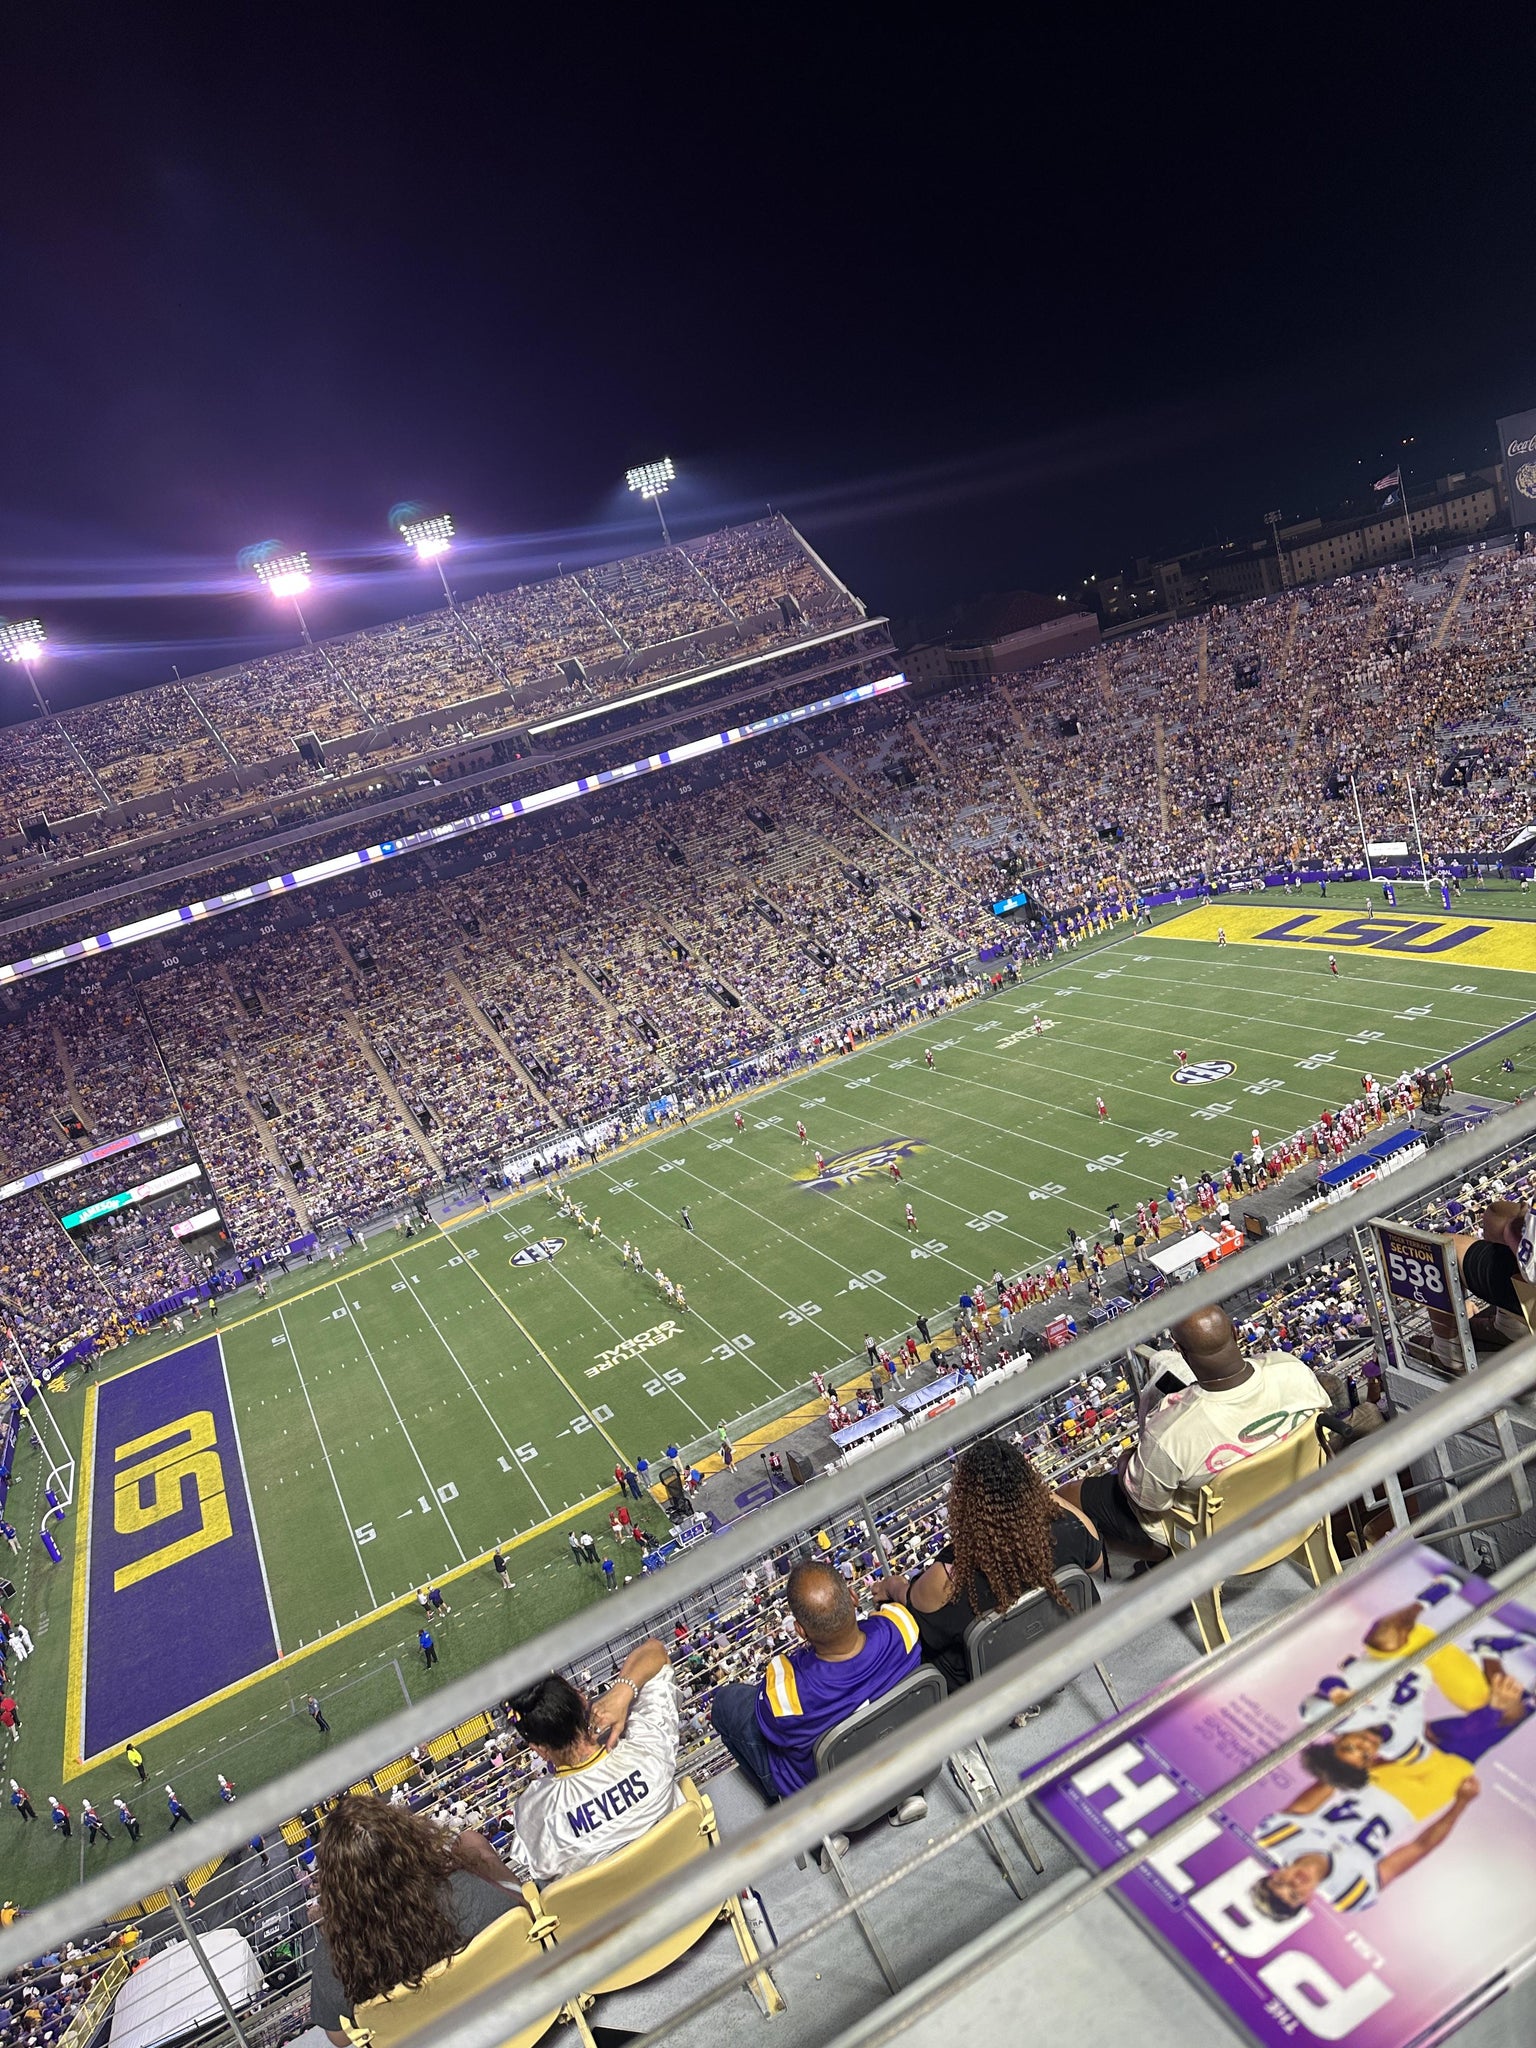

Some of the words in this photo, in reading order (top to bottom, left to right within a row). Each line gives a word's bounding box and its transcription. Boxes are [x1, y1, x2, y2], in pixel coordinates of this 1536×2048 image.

[852, 725, 865, 736] 223
[794, 744, 808, 755] 222
[753, 758, 767, 769] 106
[678, 784, 693, 795] 105
[590, 814, 605, 825] 104
[482, 850, 497, 862] 103
[367, 887, 383, 900] 102
[259, 923, 277, 937] 101
[1251, 914, 1494, 954] LSU
[161, 955, 180, 970] 100
[1449, 984, 1478, 993] 5
[1393, 1005, 1428, 1021] 10
[1346, 1029, 1385, 1045] 15
[1174, 1061, 1234, 1084] SEC
[1294, 1053, 1334, 1071] 20
[1242, 1077, 1286, 1095] 25
[1190, 1102, 1233, 1121] 30
[753, 1115, 784, 1130] 50
[706, 1137, 735, 1151] 45
[1136, 1128, 1179, 1148] 35
[658, 1158, 687, 1173] 40
[1085, 1153, 1125, 1174] 40
[608, 1178, 640, 1195] 35
[1028, 1181, 1067, 1202] 45
[964, 1210, 1009, 1232] 50
[503, 1224, 535, 1242] 25
[1388, 1234, 1406, 1246] TIGER
[1405, 1237, 1433, 1252] TERRACE
[260, 1244, 292, 1266] LSU
[448, 1247, 481, 1268] 20
[910, 1238, 949, 1261] 45
[1390, 1241, 1435, 1264] SECTION
[847, 1269, 888, 1295] 40
[1389, 1252, 1445, 1294] 538
[778, 1300, 823, 1327] 35
[271, 1333, 288, 1347] 5
[593, 1320, 677, 1361] GLOBAL
[711, 1333, 757, 1362] 30
[584, 1327, 685, 1380] VENTURE
[642, 1367, 687, 1397] 25
[568, 1403, 615, 1435] 20
[496, 1441, 539, 1473] 15
[114, 1410, 233, 1593] LSU
[416, 1481, 459, 1514] 10
[355, 1521, 376, 1546] 5
[566, 1769, 651, 1839] MEYERS
[1322, 1798, 1392, 1858] 34
[1070, 1741, 1396, 2041] PATH
[1344, 1930, 1386, 1971] LSU
[1262, 1997, 1300, 2036] THE
